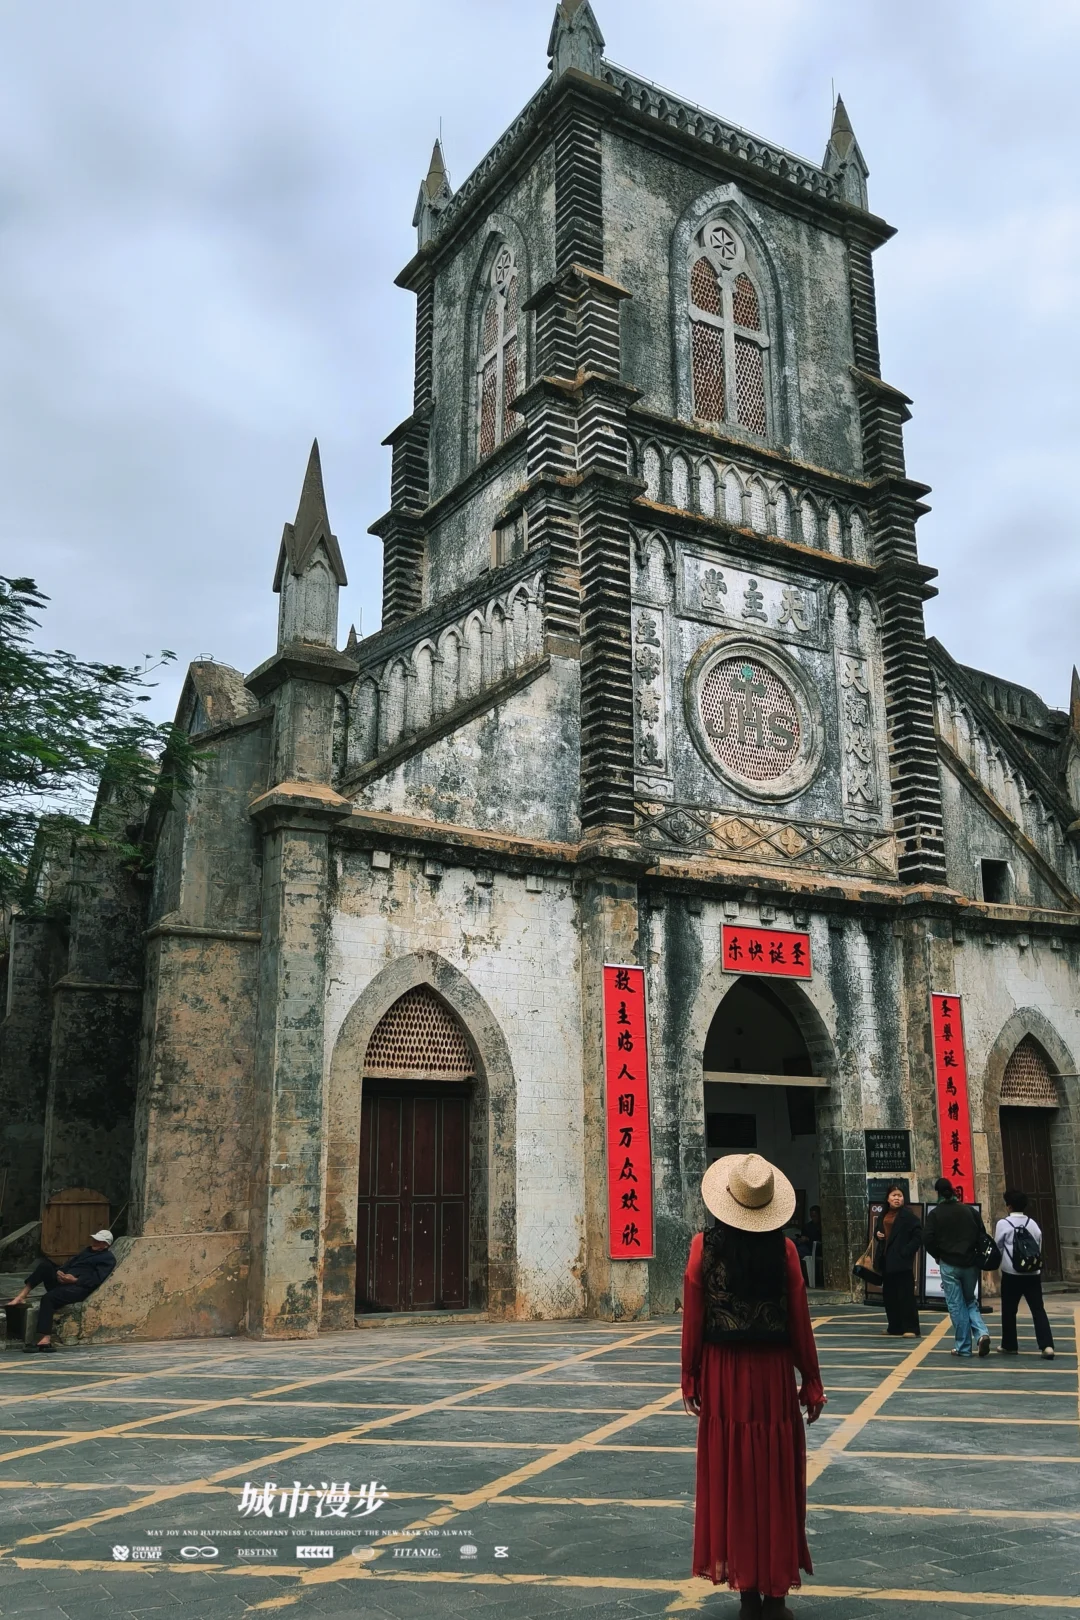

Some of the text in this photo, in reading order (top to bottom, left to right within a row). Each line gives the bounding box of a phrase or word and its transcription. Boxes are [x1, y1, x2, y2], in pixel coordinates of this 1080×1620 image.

[705, 699, 796, 751] JHS
[614, 969, 641, 1247] 救主临人间万众欢欣
